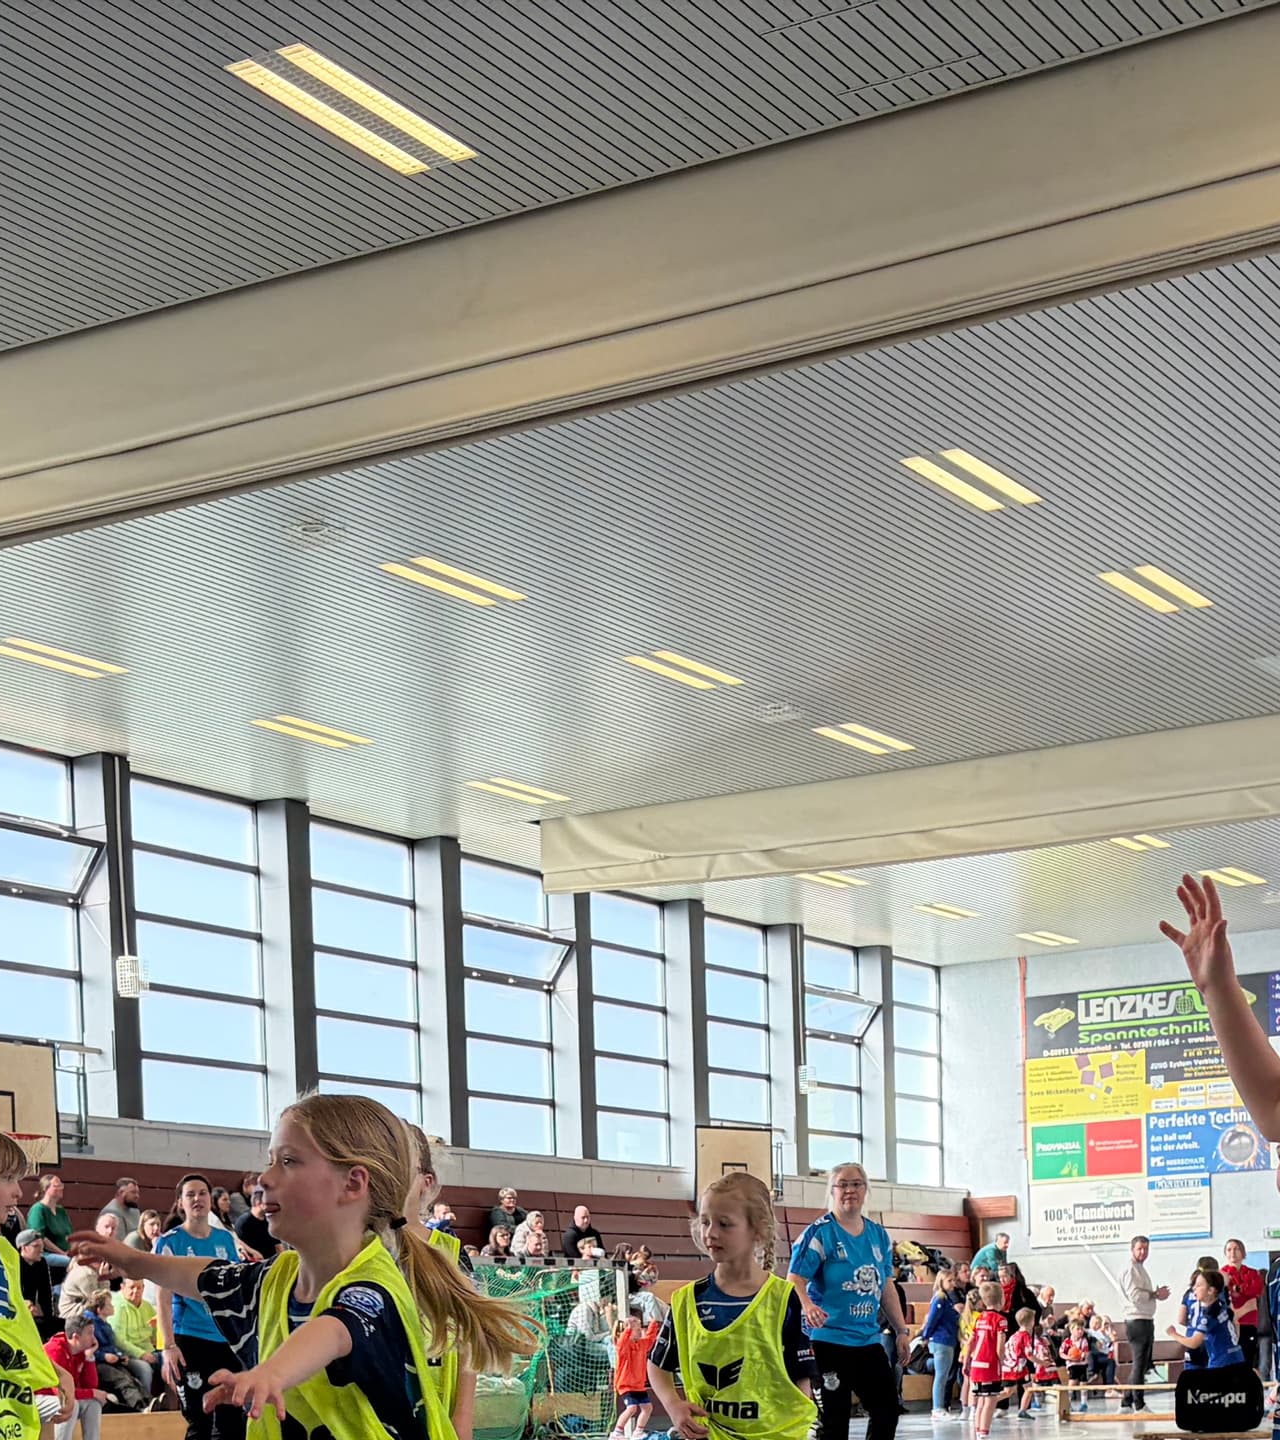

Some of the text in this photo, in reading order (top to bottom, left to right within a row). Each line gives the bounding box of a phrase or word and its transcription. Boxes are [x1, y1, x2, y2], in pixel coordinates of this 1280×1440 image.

[1078, 1021, 1210, 1045] Spanntechnik
[1149, 1112, 1207, 1130] Perfekte
[1163, 1133, 1177, 1142] Ball
[1178, 1131, 1192, 1140] und
